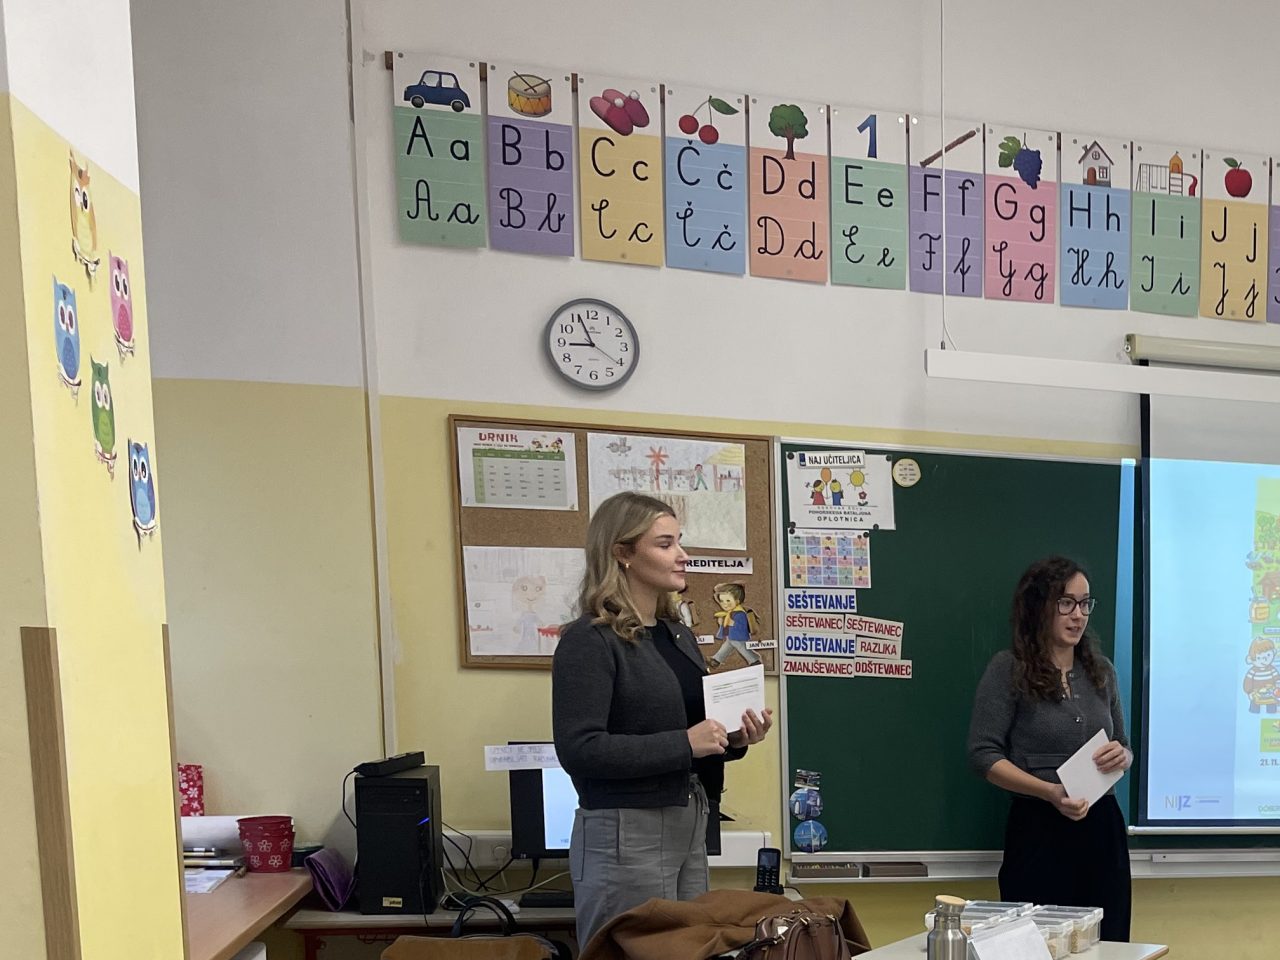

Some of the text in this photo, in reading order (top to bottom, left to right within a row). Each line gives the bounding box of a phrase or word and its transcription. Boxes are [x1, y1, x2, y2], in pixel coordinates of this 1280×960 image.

[586, 310, 598, 320] 12
[606, 316, 610, 325] 1
[560, 324, 574, 334] 10
[615, 328, 623, 337] 2
[557, 338, 566, 347] 9
[620, 342, 628, 352] 3
[562, 353, 571, 363] 8
[616, 358, 624, 366] 4
[574, 365, 582, 374] 7
[605, 368, 614, 377] 5
[589, 371, 598, 380] 6
[809, 454, 861, 465] NAJ UČITELJICA
[788, 591, 855, 609] SEŠTEVANJE
[786, 614, 843, 630] SEŠTEVANEC
[846, 617, 901, 637] SEŠTEVANEC
[786, 633, 855, 654] ODŠTEVANJE
[860, 641, 897, 655] RAZLIKA
[784, 660, 853, 675] ZMANJŠEVANEC
[855, 661, 911, 676] ODŠTEVANEC
[1165, 795, 1191, 811] NIJZ
